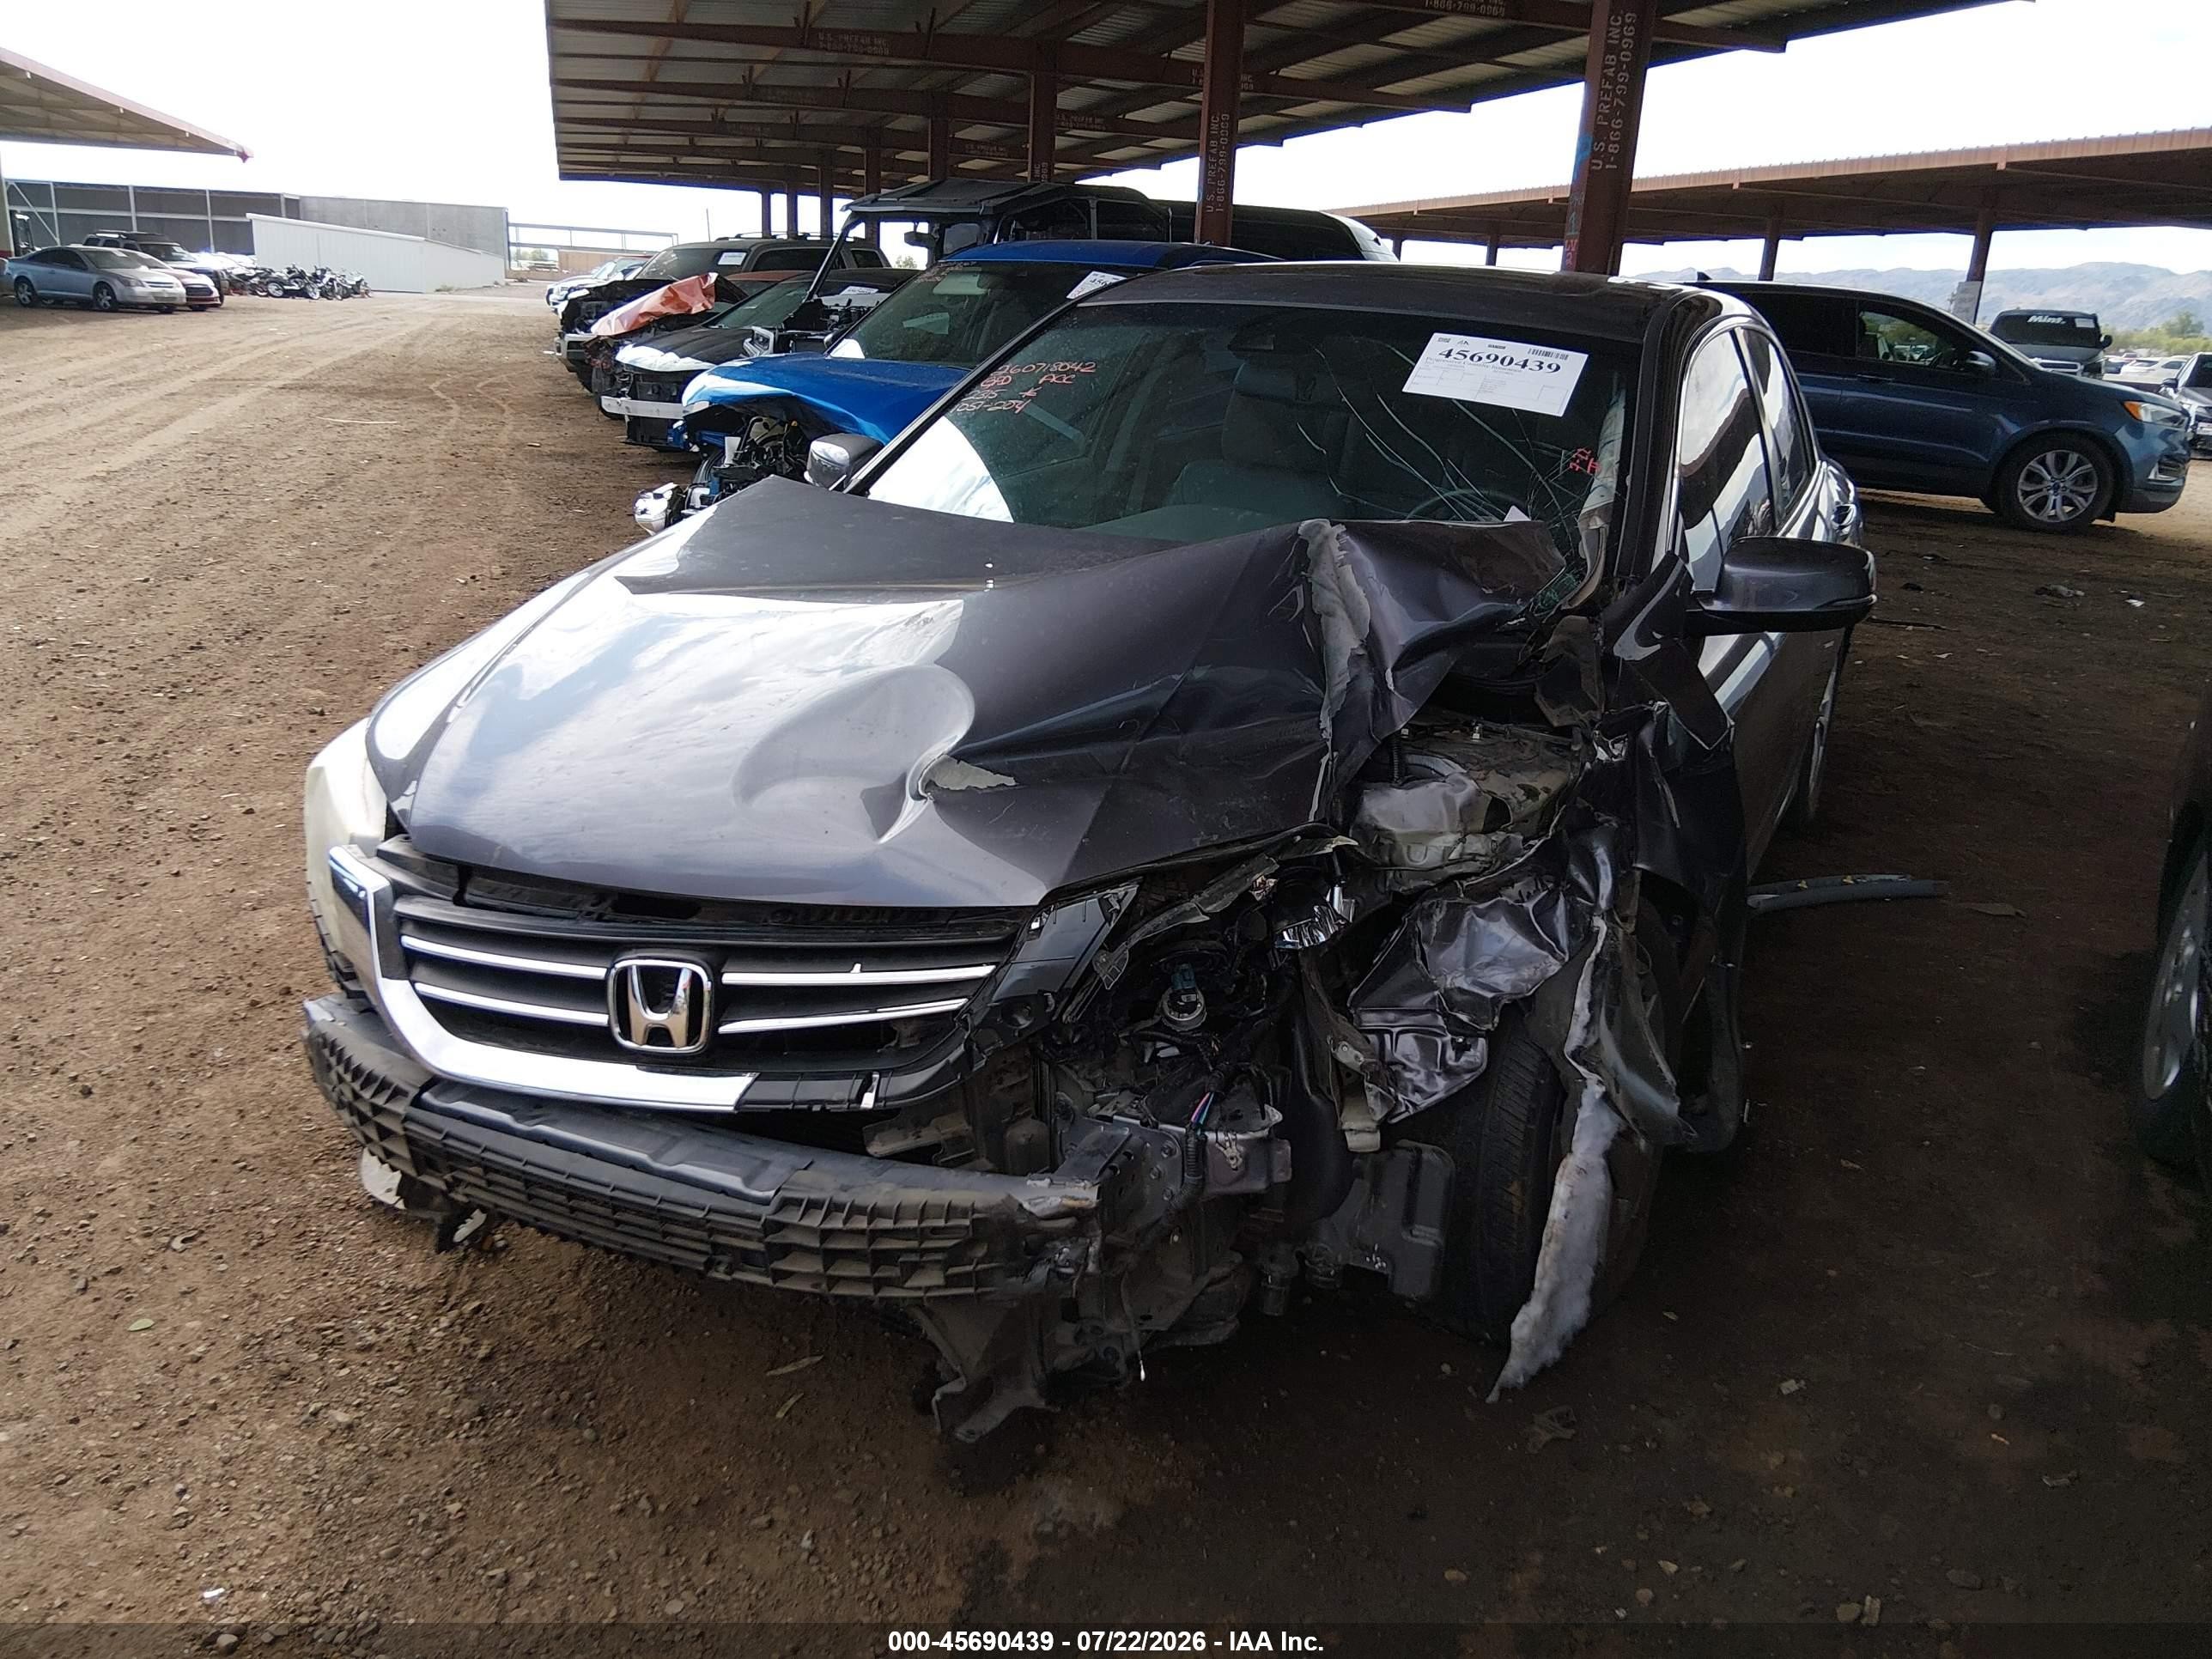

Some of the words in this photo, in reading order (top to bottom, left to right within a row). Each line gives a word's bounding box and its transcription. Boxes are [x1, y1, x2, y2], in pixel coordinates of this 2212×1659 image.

[1596, 54, 1617, 125] PREFAB
[1606, 12, 1637, 169] 1-866-799-0969
[1207, 140, 1218, 185] PREFAB
[1591, 137, 1607, 170] U.S.
[1206, 191, 1216, 213] U.S.
[990, 362, 1096, 376] 260718042
[1438, 347, 1561, 374] 45690439
